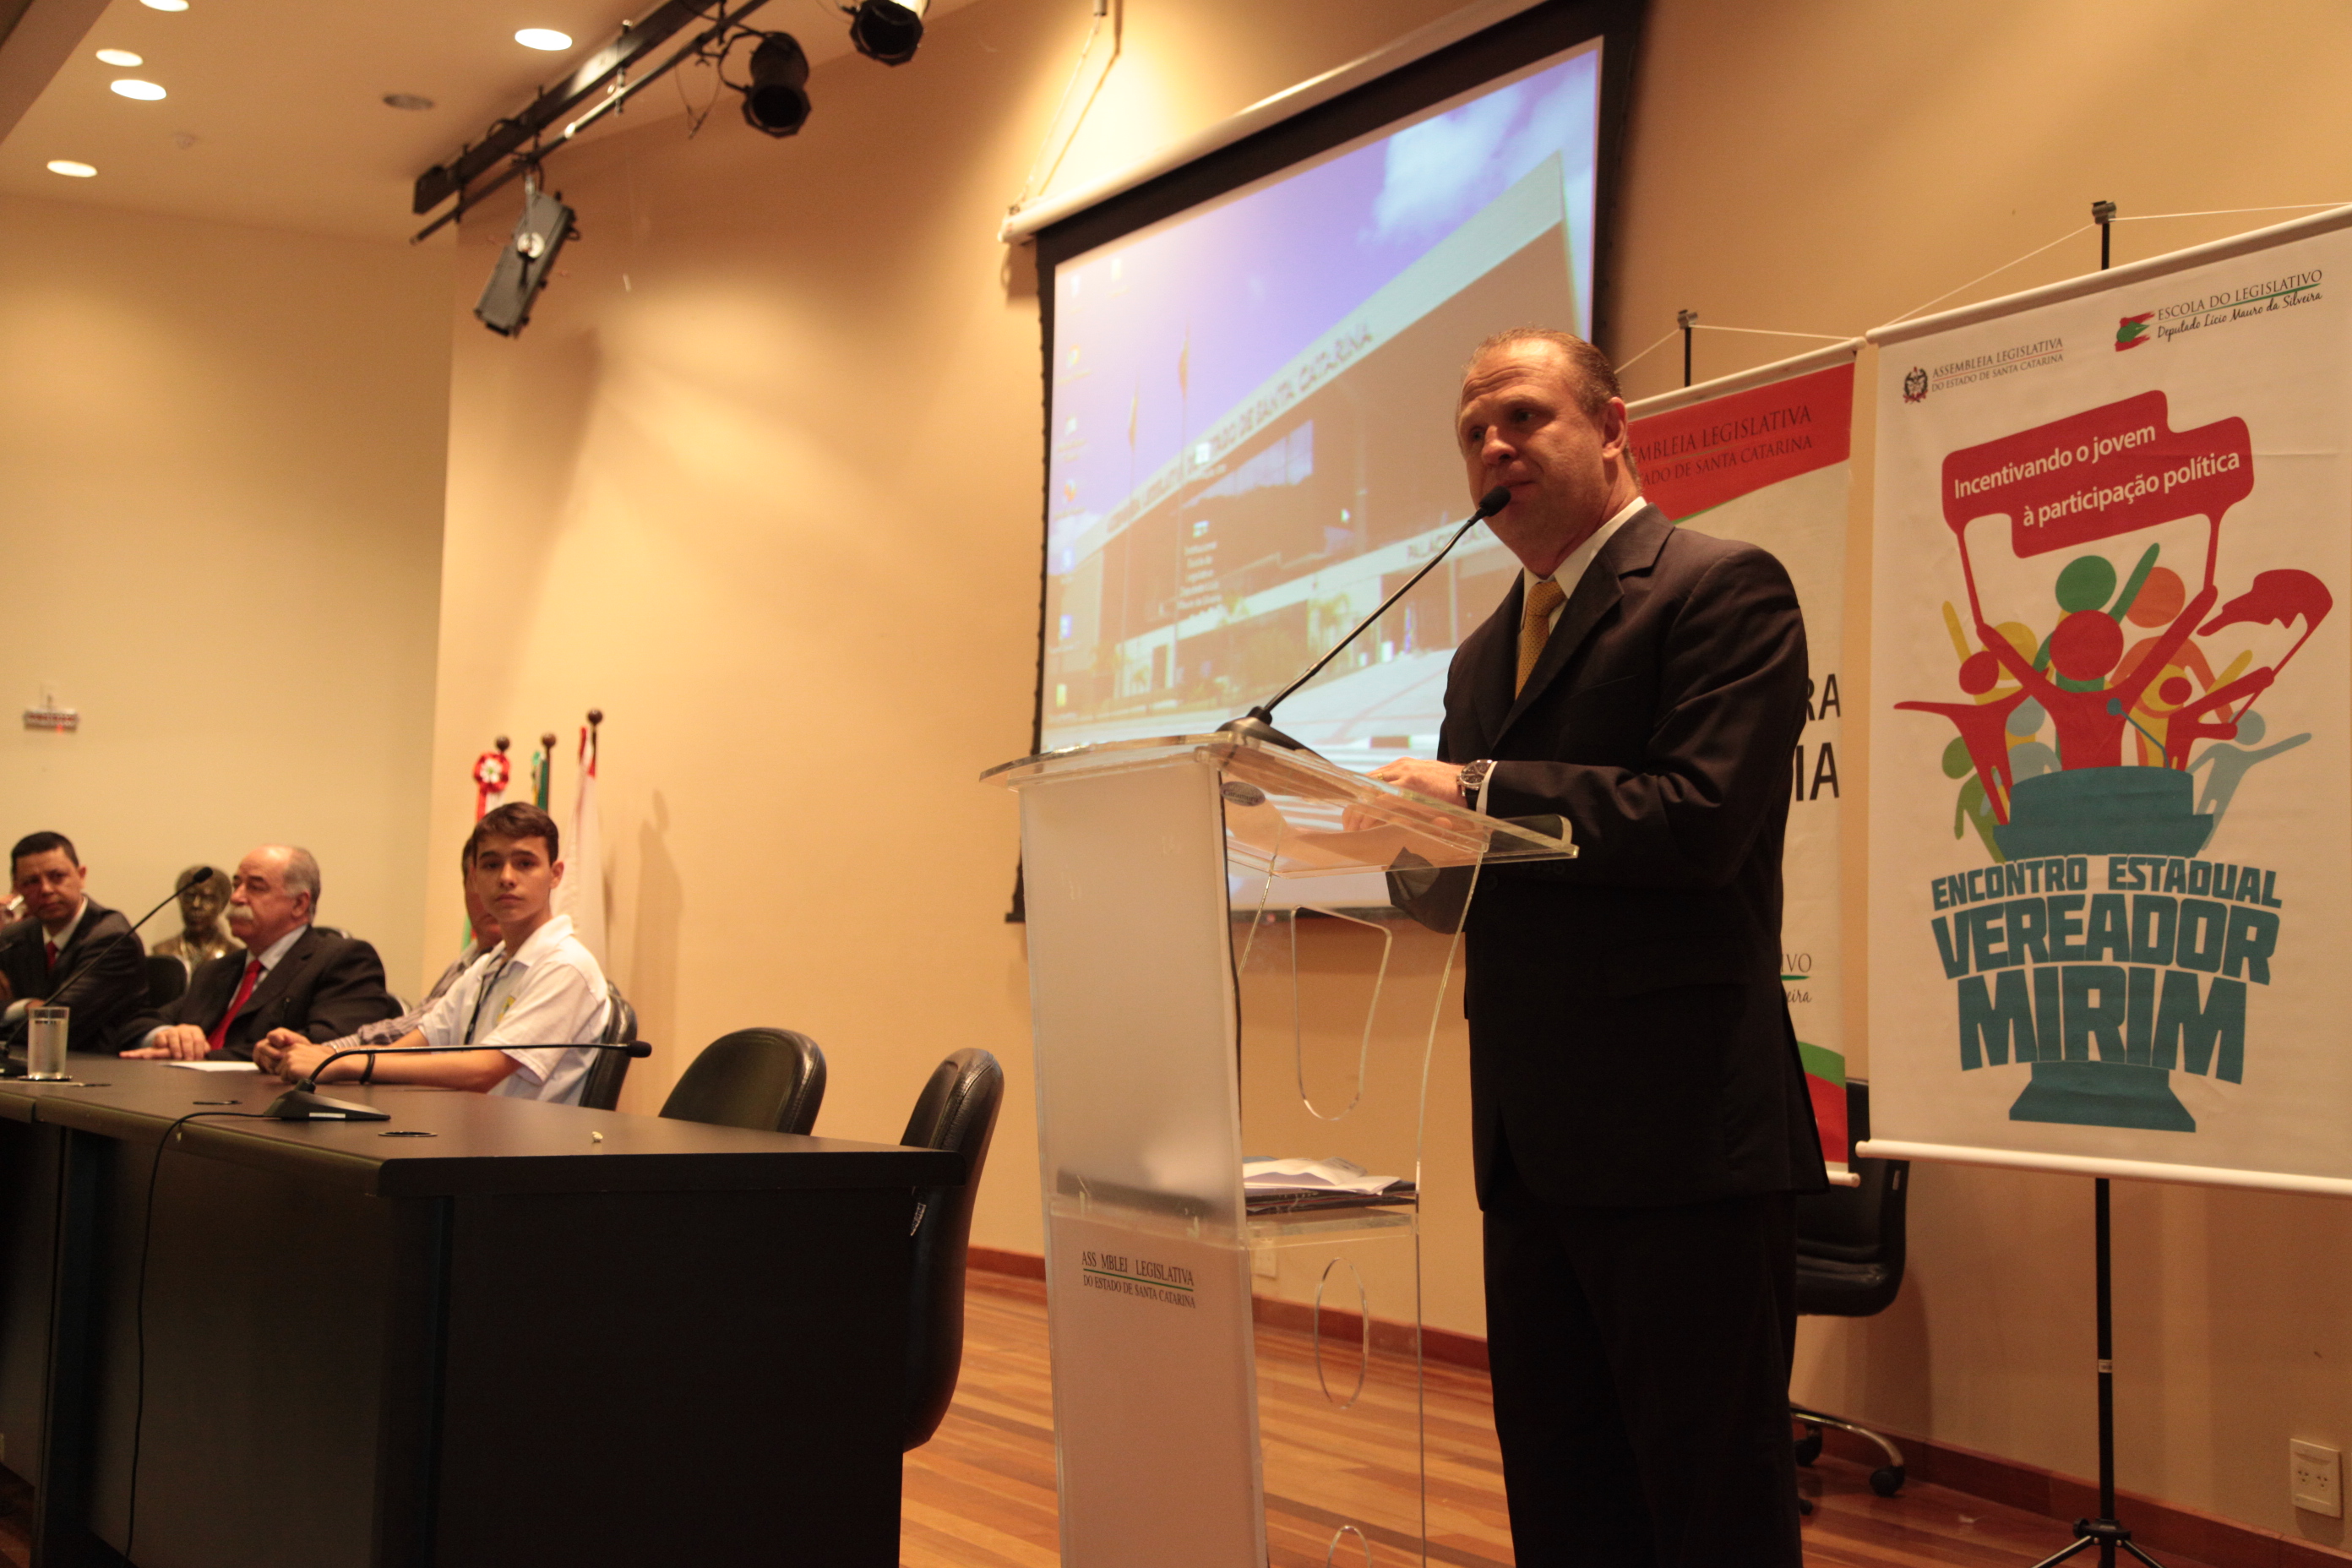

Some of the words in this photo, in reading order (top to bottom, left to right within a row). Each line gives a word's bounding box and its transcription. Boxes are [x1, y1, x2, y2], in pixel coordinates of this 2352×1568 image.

[2158, 299, 2205, 321] ESCOLA
[2209, 292, 2230, 308] DO
[2235, 270, 2322, 302] LEGISLATIVO
[2158, 318, 2201, 342] Deputado
[2204, 313, 2227, 327] Lício
[2230, 306, 2263, 323] Mauro
[2267, 298, 2280, 312] da
[2282, 291, 2323, 309] Silveira
[1931, 383, 1944, 392] DO
[1946, 373, 1977, 389] ESTADO
[1979, 371, 1990, 381] DE
[1992, 364, 2018, 378] SANTA
[2020, 354, 2064, 371] CATARINA
[1932, 355, 1993, 378] ASSEMBLEIA
[1996, 338, 2063, 363] LEGISLATIVA
[1631, 433, 1696, 464] EMBLEIA
[1702, 405, 1811, 448] LEGISLATIVA
[1675, 462, 1691, 479] DE
[1696, 452, 1737, 475] SANTA
[1740, 435, 1812, 463] CATARINA
[1954, 448, 2072, 498] Incentivando
[2076, 445, 2089, 462] o
[2092, 425, 2156, 463] jovem
[2023, 505, 2034, 526] à
[2038, 474, 2159, 528] participação
[2164, 452, 2240, 493] política
[1808, 673, 1841, 721] RA
[1796, 742, 1840, 802] IA
[1931, 857, 2088, 912] ENCONTRO
[2108, 856, 2282, 908] ESTADUAL
[1931, 893, 2281, 986] VEREADOR
[1957, 965, 2247, 1086] MIRIM
[1083, 1275, 1093, 1287] DO
[1095, 1277, 1122, 1293] ESTADO
[1124, 1282, 1133, 1295] DE
[1135, 1284, 1157, 1300] SANTA
[1159, 1289, 1195, 1309] CATARINA
[1135, 1260, 1195, 1286] LEGISLATIVA
